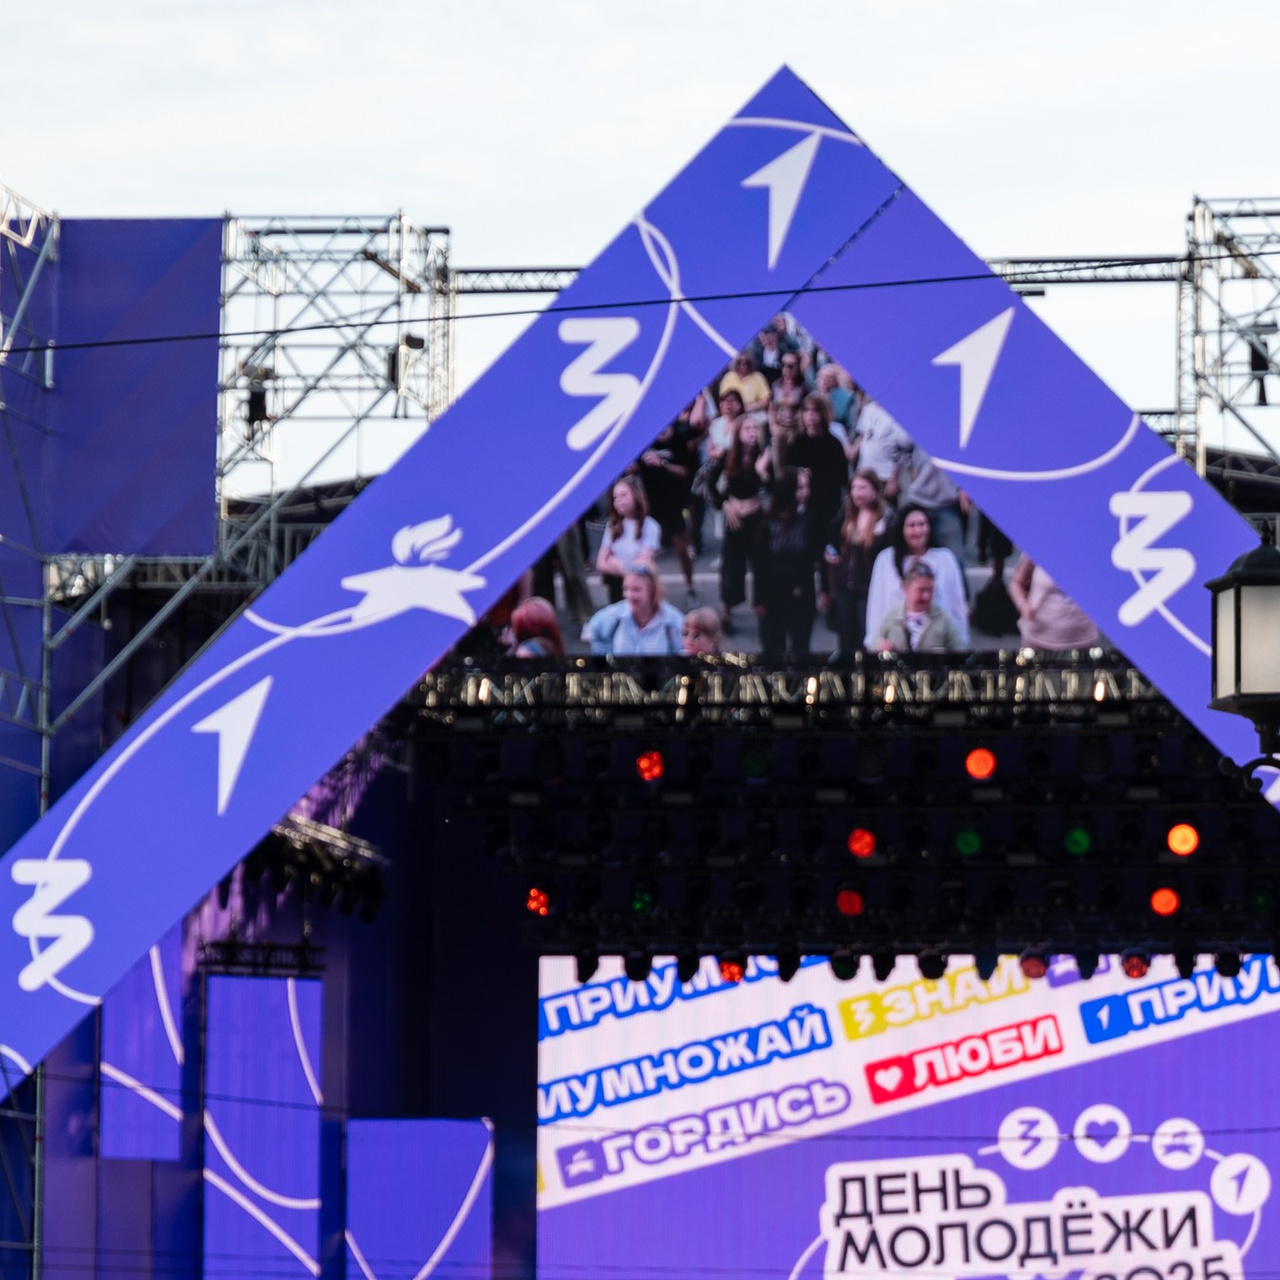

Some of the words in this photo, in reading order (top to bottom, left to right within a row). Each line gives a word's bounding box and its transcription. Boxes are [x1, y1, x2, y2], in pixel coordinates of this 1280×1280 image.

[603, 1083, 848, 1173] ГОРДИСЬ
[912, 1018, 1060, 1088] ЛЮБИ
[835, 1168, 993, 1227] ДЕНЬ
[838, 1201, 1200, 1273] МОЛОДЁЖИ
